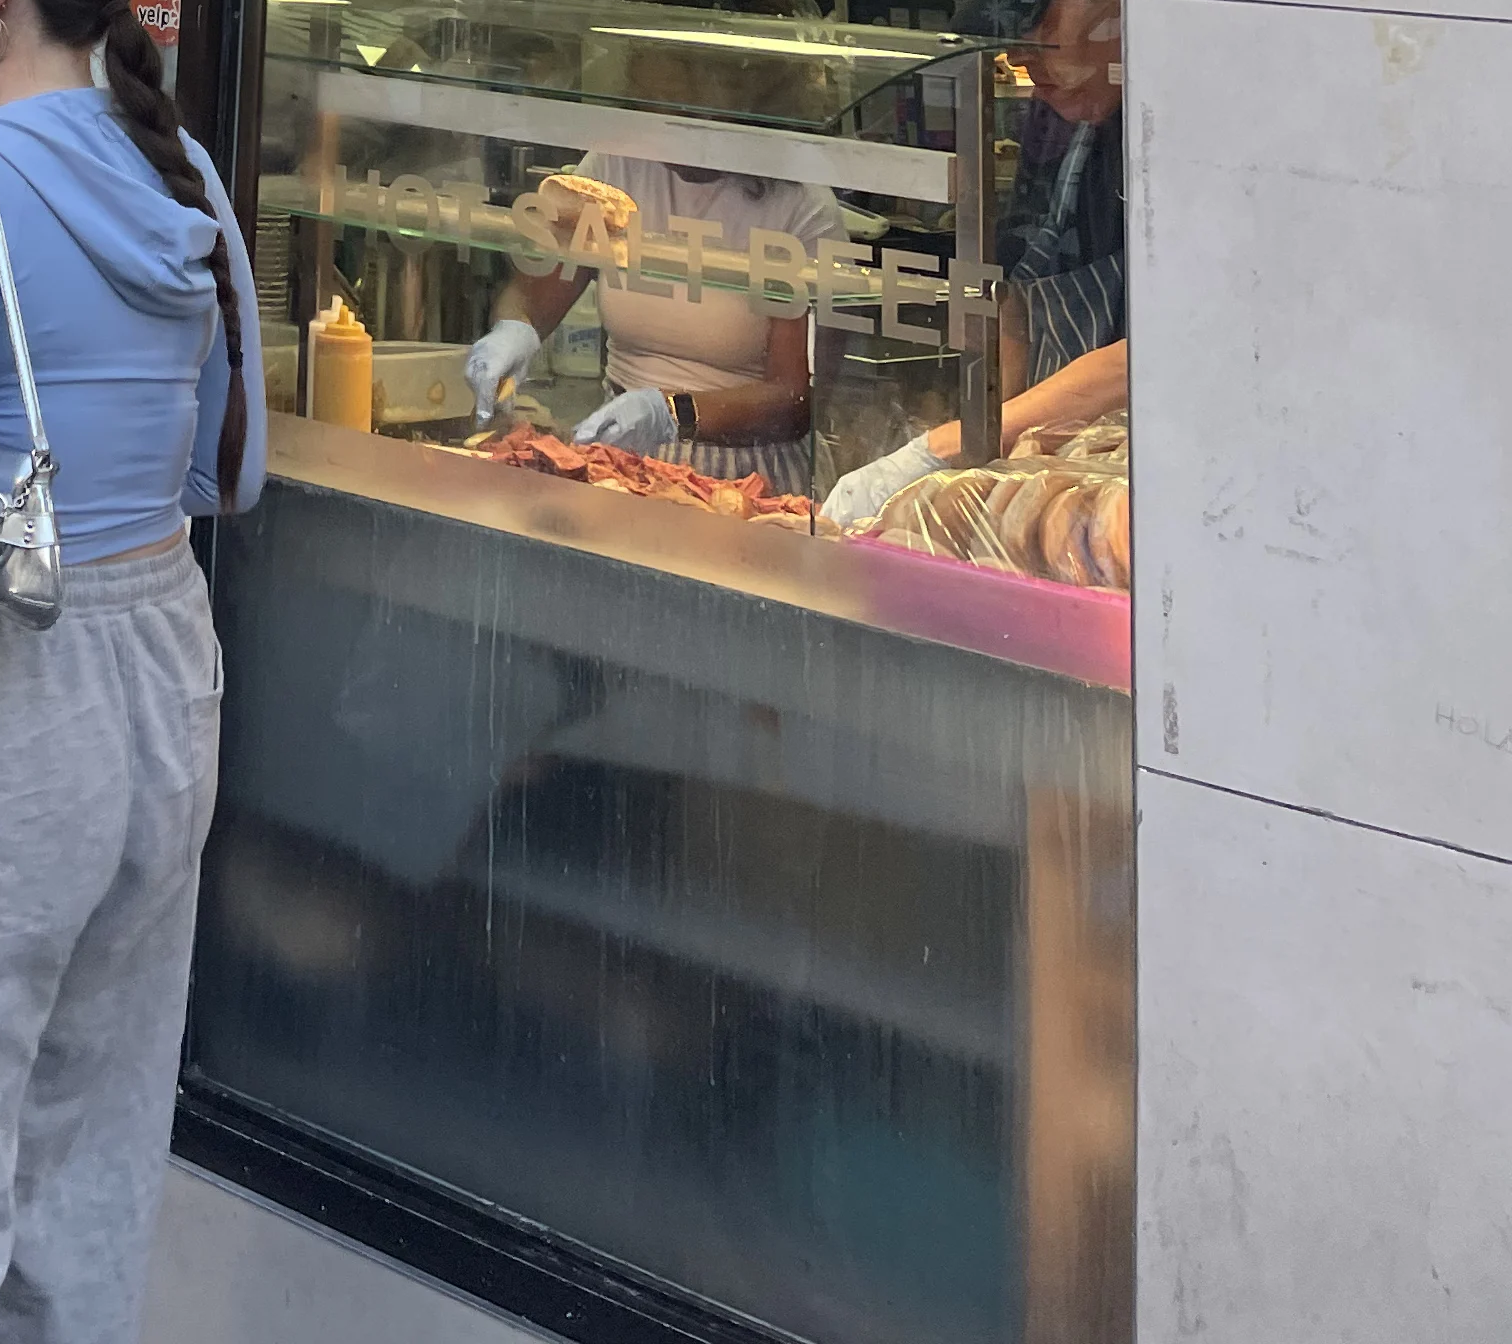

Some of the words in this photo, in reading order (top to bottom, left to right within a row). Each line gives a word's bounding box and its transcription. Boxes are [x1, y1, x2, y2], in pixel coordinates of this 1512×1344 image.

[137, 3, 172, 31] yelp
[333, 164, 494, 263] HOT
[506, 190, 725, 306] SALT
[747, 226, 1005, 352] BEEF
